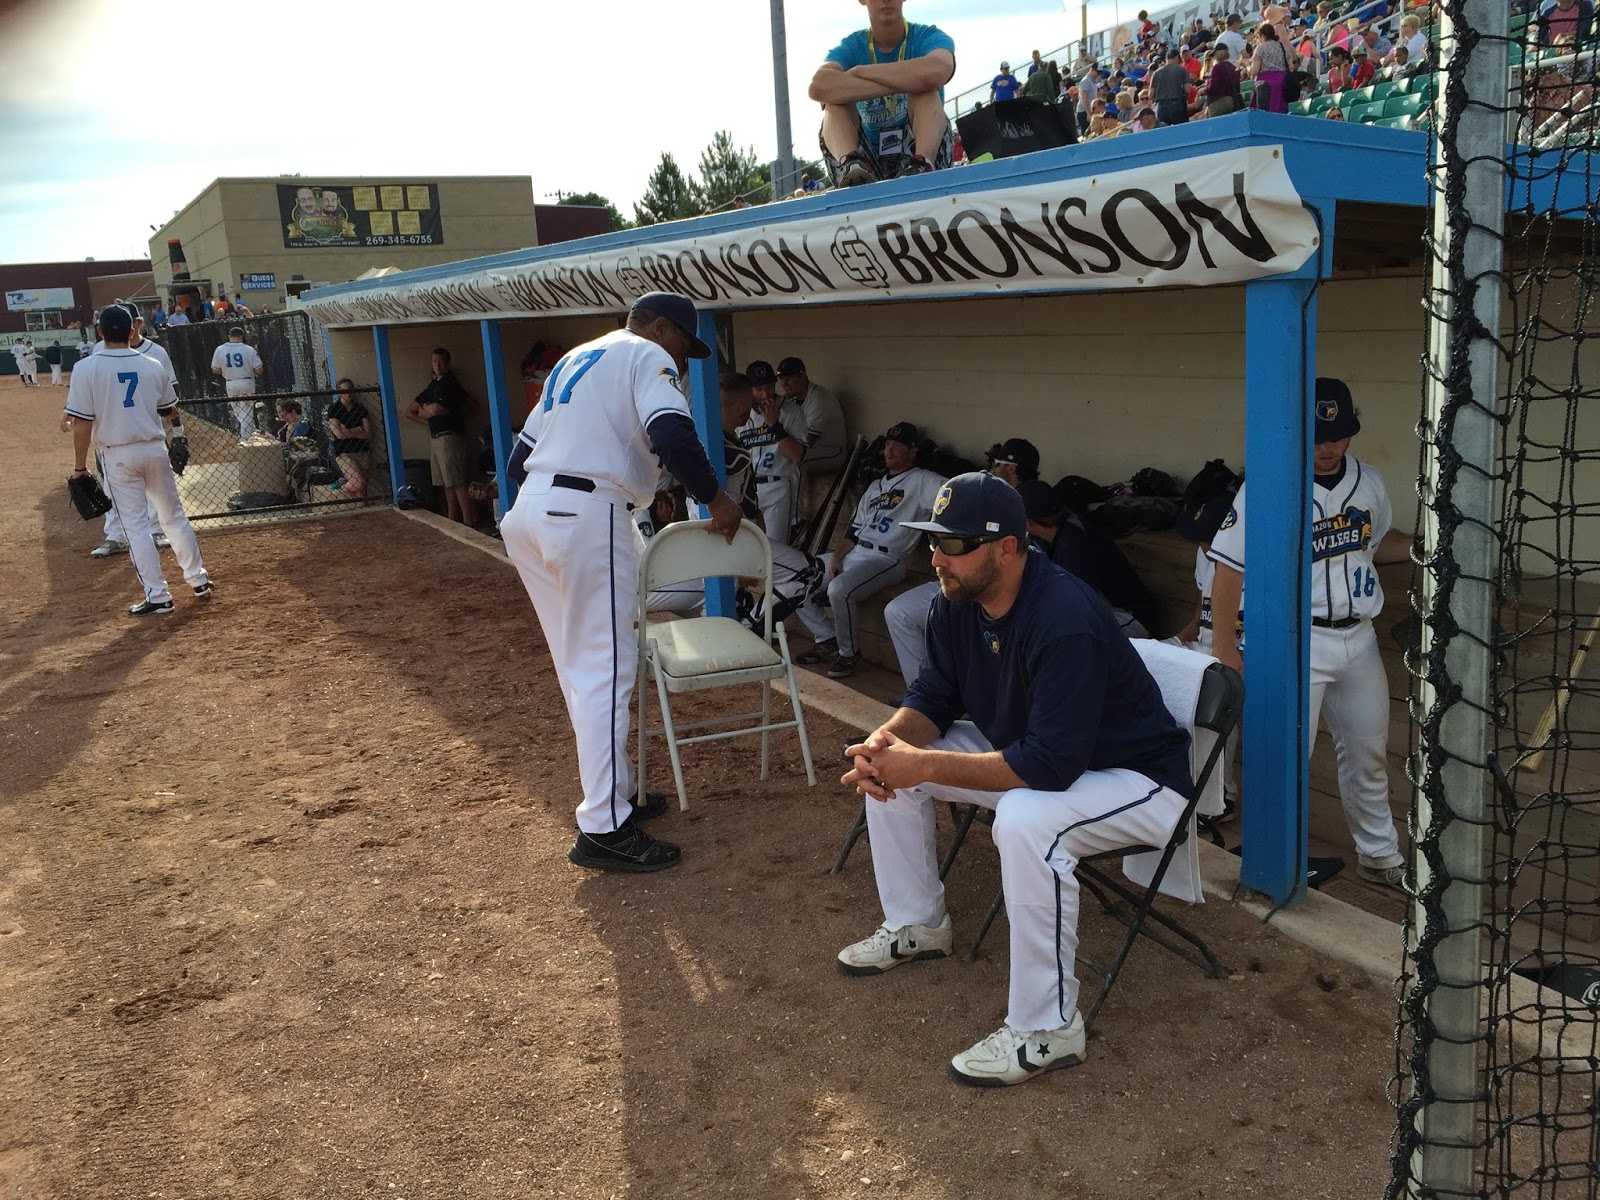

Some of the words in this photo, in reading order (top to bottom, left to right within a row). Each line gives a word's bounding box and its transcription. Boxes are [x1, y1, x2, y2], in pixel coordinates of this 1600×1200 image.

[366, 235, 433, 246] 269-345-6755
[416, 280, 500, 317] BRONSON
[507, 262, 626, 311] BRONSON
[640, 234, 837, 301] BRONSON
[876, 171, 1278, 285] BRONSON
[242, 281, 276, 289] SERVICES
[251, 274, 274, 282] GUEST
[225, 352, 244, 368] 19
[117, 371, 139, 408] 7
[543, 348, 607, 414] 17
[762, 452, 775, 469] 2
[1352, 566, 1376, 598] 16
